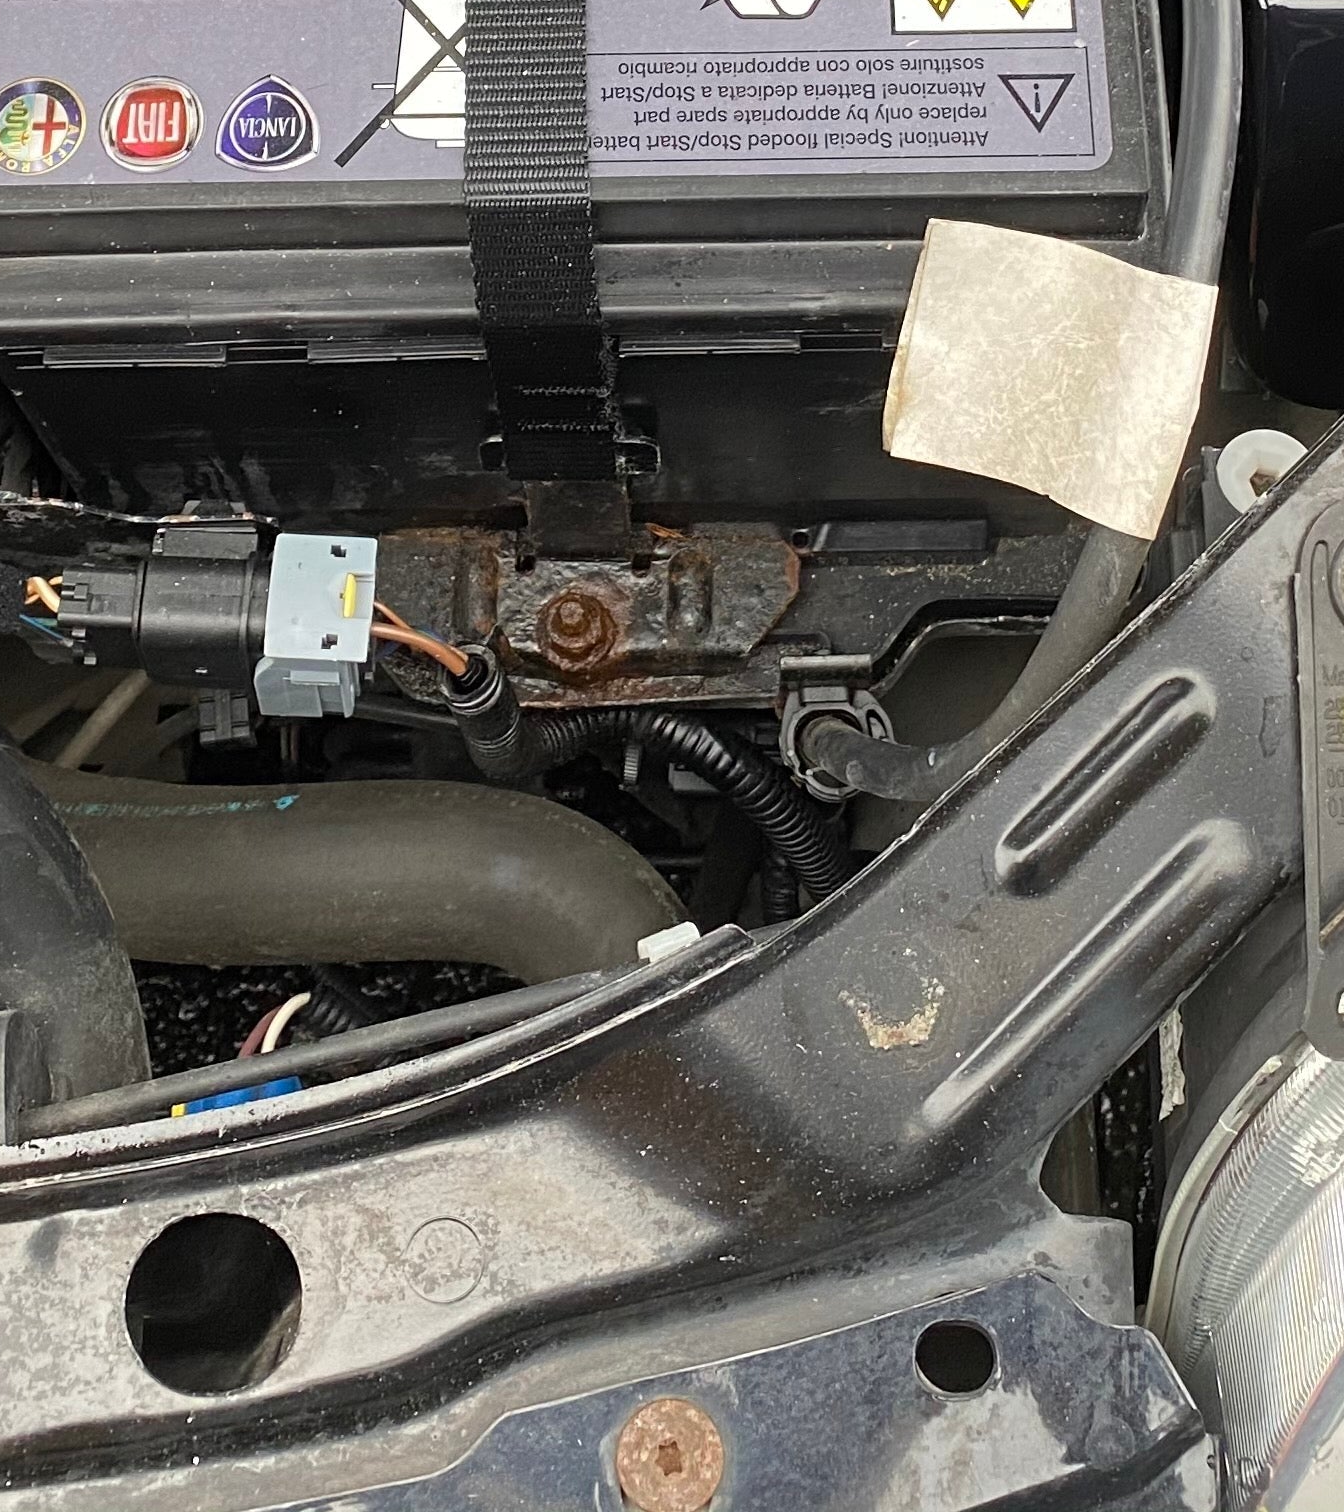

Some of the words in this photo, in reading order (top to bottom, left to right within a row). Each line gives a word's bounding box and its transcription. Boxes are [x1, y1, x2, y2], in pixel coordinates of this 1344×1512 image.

[618, 61, 698, 78] ricambio
[704, 57, 811, 77] appropriato
[816, 59, 850, 74] con
[856, 59, 894, 76] solo
[900, 57, 984, 75] sostituire
[601, 84, 695, 103] Stop/Start
[701, 85, 712, 99] a
[718, 84, 798, 101] dedicata
[804, 83, 875, 100] Batteria
[882, 82, 986, 99] Attenzione!
[122, 101, 181, 143] FIAT
[634, 108, 670, 126] part
[675, 107, 727, 124] spare
[733, 106, 840, 125] appropriate
[846, 106, 869, 125] by
[874, 105, 914, 123] only
[918, 105, 987, 122] replace
[238, 117, 297, 139] LANCIA
[42, 123, 80, 166] ALFA
[646, 132, 741, 151] Stop/Start
[747, 132, 818, 150] flooded
[824, 129, 893, 148] Special
[898, 130, 988, 147] Attention!
